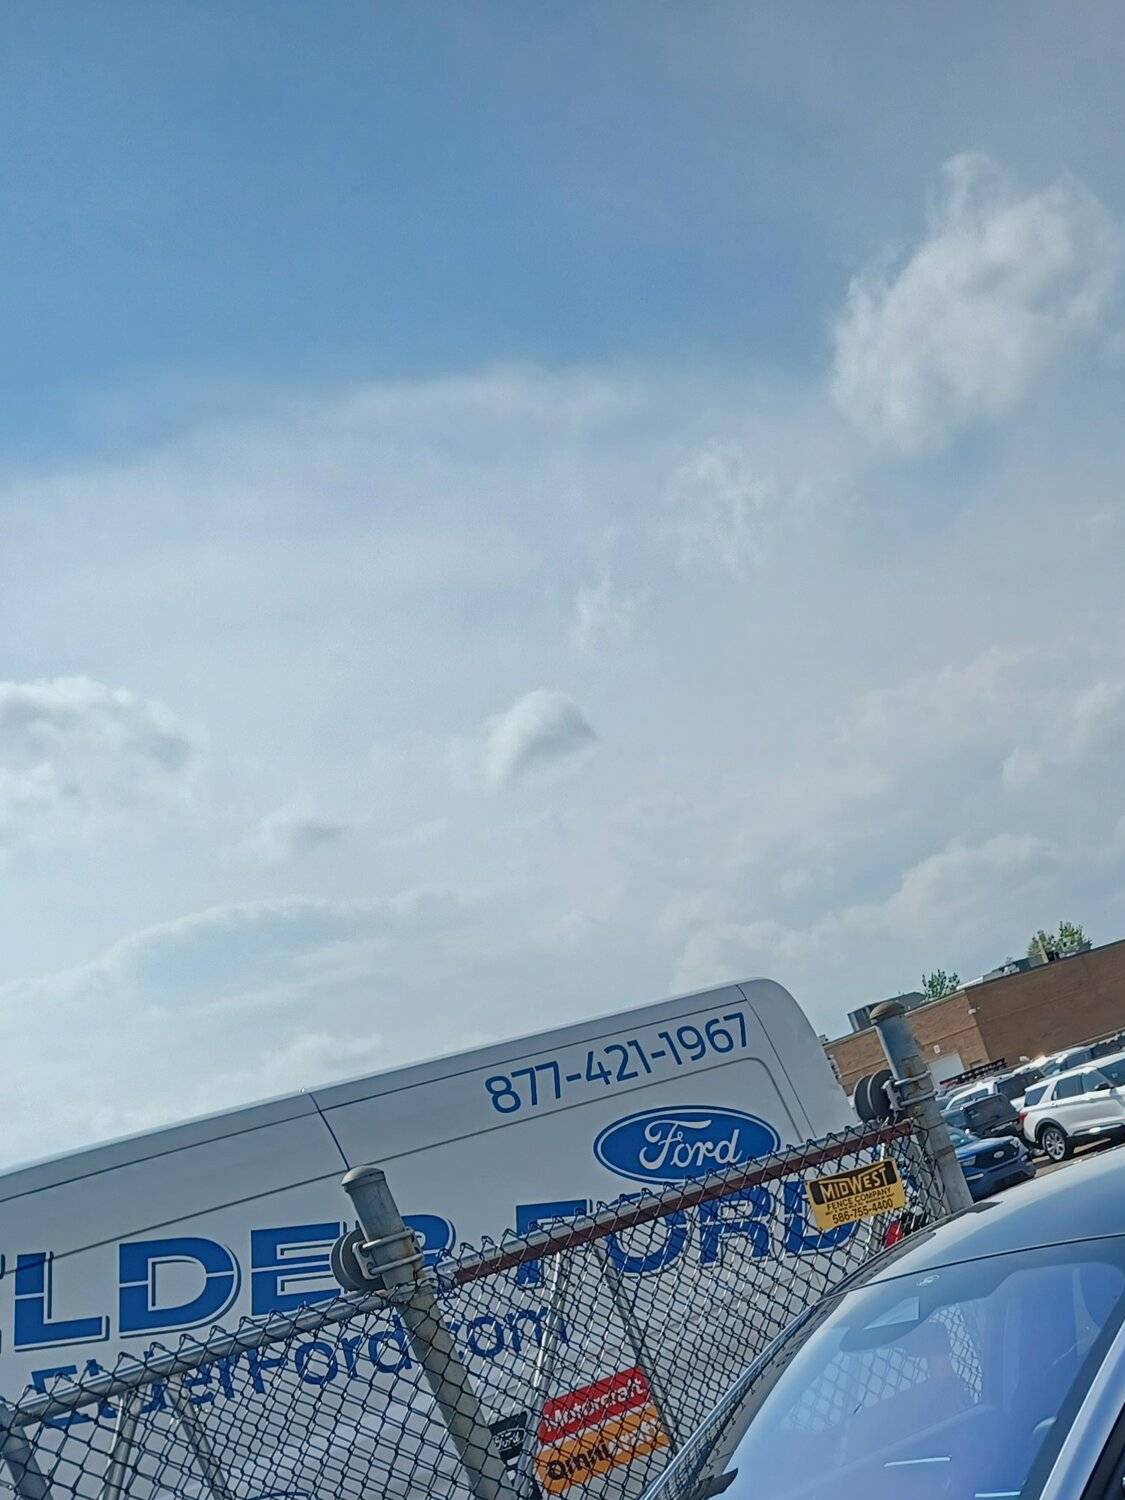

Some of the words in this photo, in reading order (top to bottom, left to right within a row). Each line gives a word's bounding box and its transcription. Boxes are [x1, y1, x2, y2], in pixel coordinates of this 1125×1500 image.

[485, 1012, 747, 1114] 877-421-1967
[638, 1119, 743, 1170] Ford
[820, 1166, 888, 1204] MIDWEST
[827, 1196, 852, 1212] FENCE
[854, 1187, 892, 1205] COMPANY
[832, 1198, 893, 1224] 586-755-4400
[0, 1214, 458, 1352] LDE
[544, 1377, 647, 1434] Motorcraft
